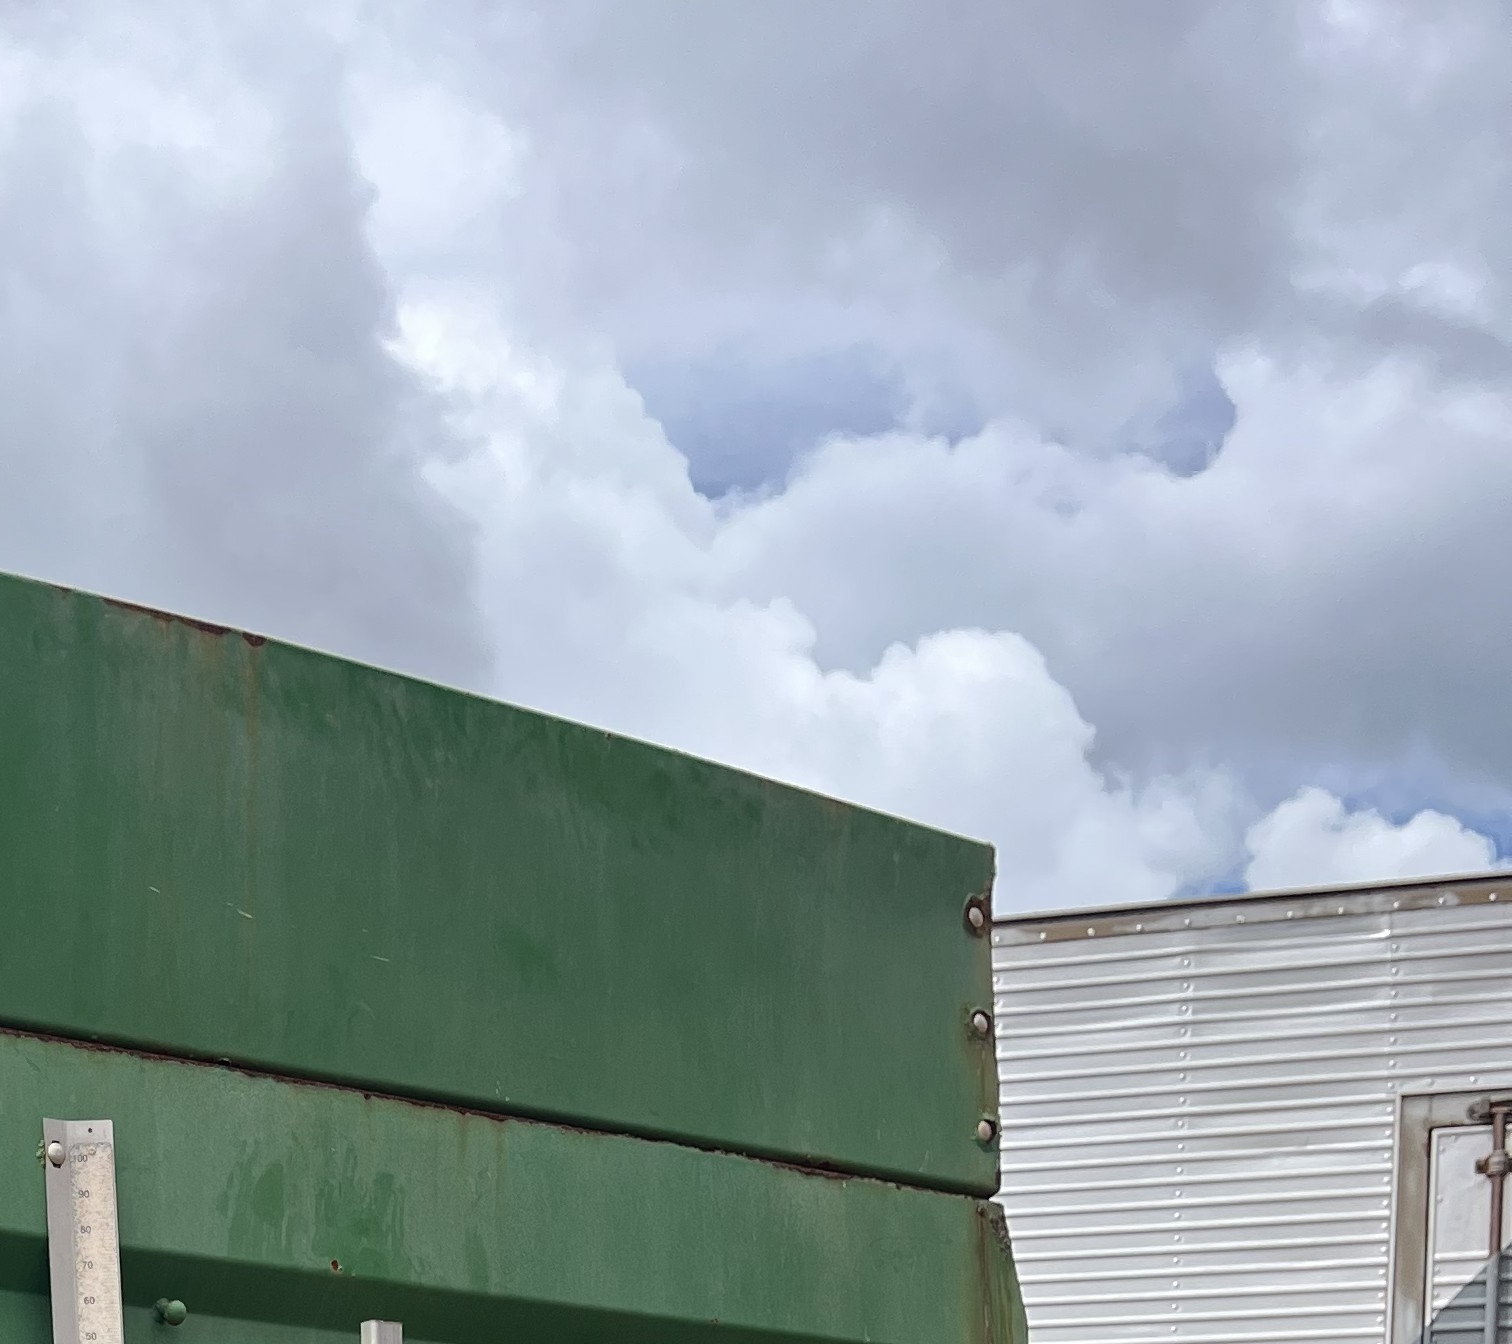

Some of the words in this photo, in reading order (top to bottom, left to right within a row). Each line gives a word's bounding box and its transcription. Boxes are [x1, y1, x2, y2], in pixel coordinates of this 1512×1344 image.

[72, 1154, 88, 1163] 100
[78, 1190, 90, 1198] 90
[80, 1225, 92, 1234] 80
[82, 1261, 94, 1270] 70
[83, 1296, 96, 1305] 60
[85, 1332, 97, 1341] 50
